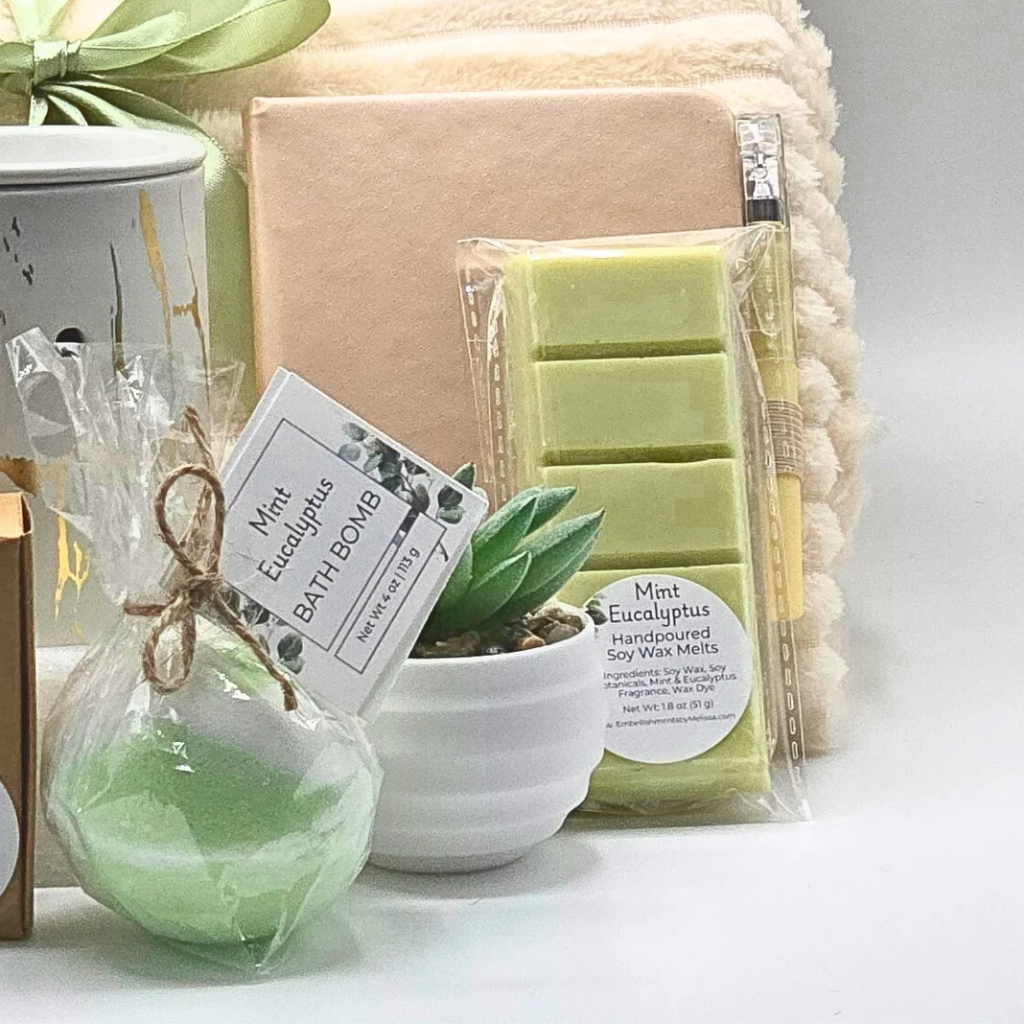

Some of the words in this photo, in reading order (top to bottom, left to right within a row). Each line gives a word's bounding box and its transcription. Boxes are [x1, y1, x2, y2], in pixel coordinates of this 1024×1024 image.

[248, 486, 291, 536] Mint
[258, 476, 334, 582] Eucalyptus
[293, 560, 340, 624] BATH
[329, 489, 381, 562] BOMB
[356, 620, 376, 643] Net
[382, 593, 391, 603] 4
[388, 578, 401, 593] oz
[397, 556, 413, 573] 113
[409, 547, 420, 558] g
[634, 581, 681, 600] Mint
[609, 601, 710, 627] Eucalyptus
[612, 626, 711, 646] Handpoured
[607, 648, 634, 663] Soy
[638, 646, 673, 659] Wax
[677, 641, 719, 657] Melts
[649, 676, 671, 686] Mint
[674, 677, 681, 685] &
[683, 672, 737, 685] Eucalyptus
[663, 666, 681, 677] Soy
[709, 663, 726, 673] Soy
[671, 685, 693, 694] Wax
[696, 684, 715, 694] Dye
[623, 703, 641, 714] Net
[676, 701, 687, 710] oz
[689, 699, 702, 710] (51
[703, 698, 714, 710] g)
